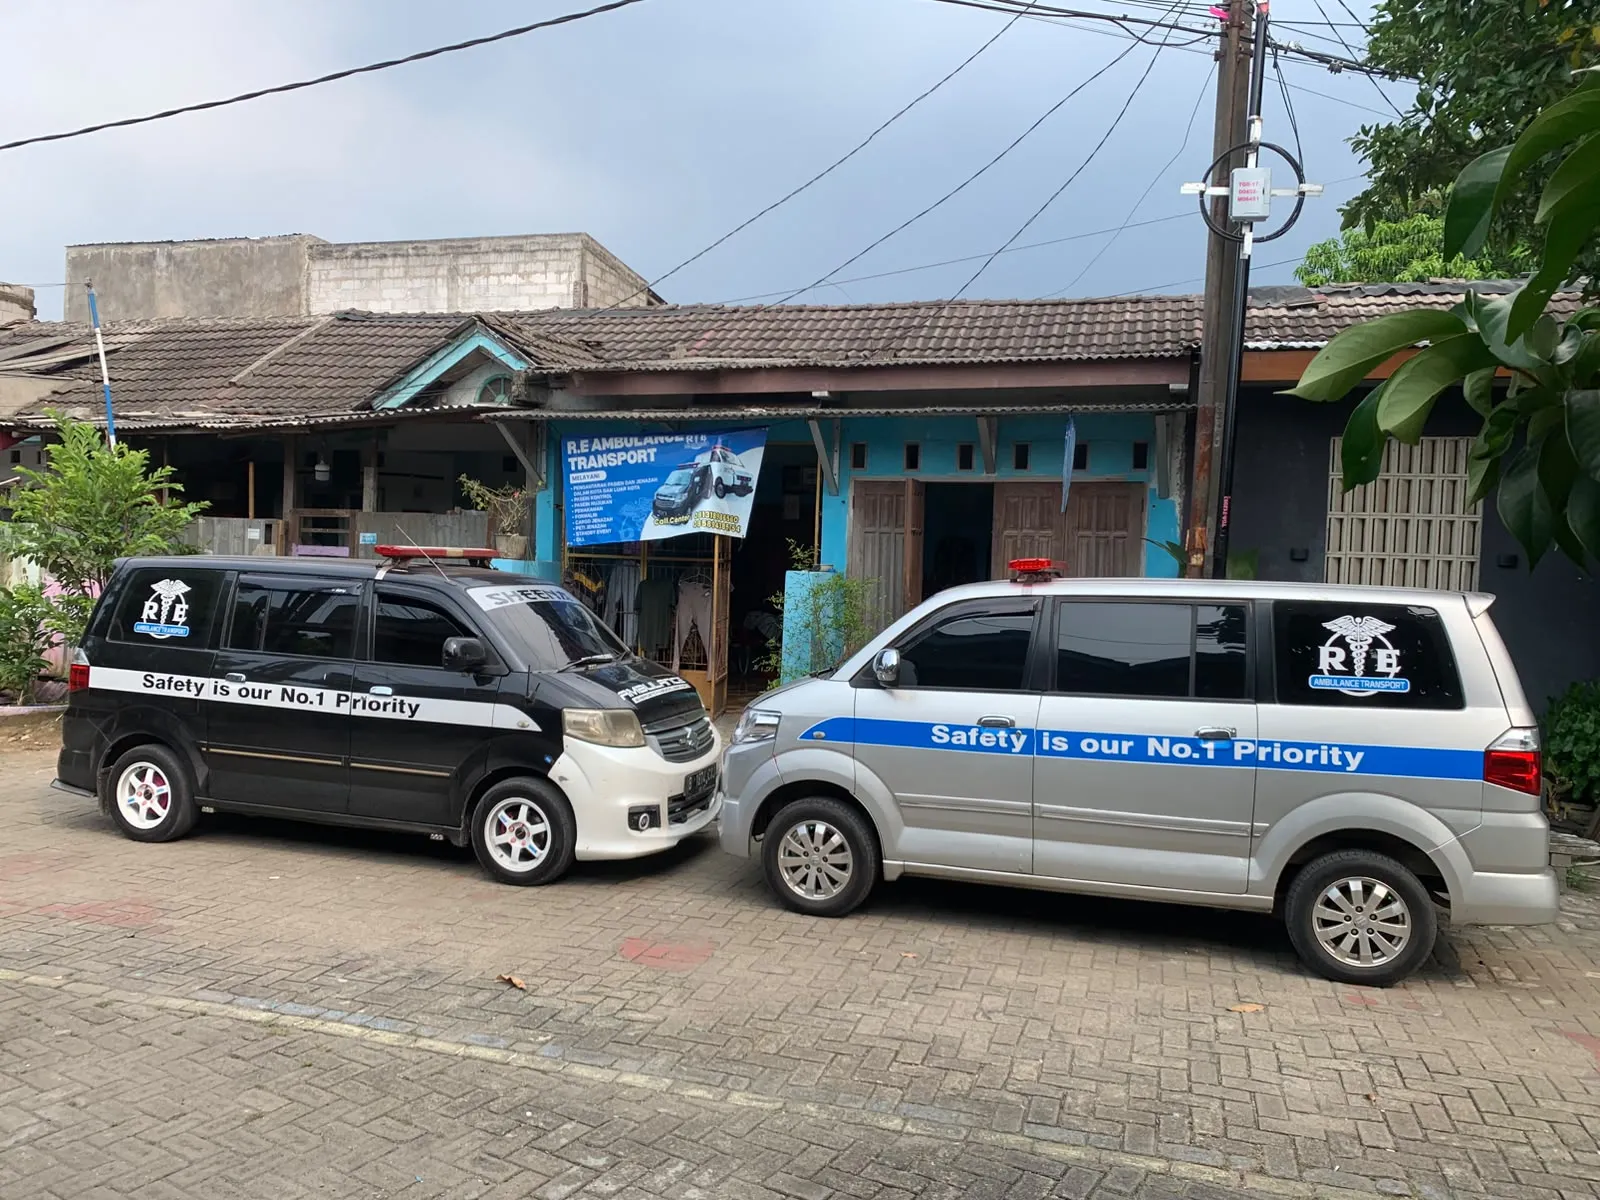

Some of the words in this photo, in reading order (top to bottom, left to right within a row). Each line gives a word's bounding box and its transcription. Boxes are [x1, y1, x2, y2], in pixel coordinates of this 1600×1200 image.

[568, 448, 657, 471] TRANSPORT
[571, 473, 600, 482] MELAYANI
[140, 600, 159, 620] R
[172, 603, 189, 623] E
[1318, 646, 1349, 671] R
[1375, 648, 1402, 673] E
[1313, 678, 1360, 688] AMBULANCE
[1361, 679, 1406, 690] TRANSPORT
[142, 673, 205, 697] Safety
[213, 681, 230, 696] is
[237, 686, 272, 701] our
[280, 687, 324, 706] No.1
[336, 692, 420, 719] Priority
[931, 724, 1028, 753] Safety
[1042, 732, 1069, 751] is
[1080, 738, 1134, 755] our
[1147, 737, 1215, 760] No.1
[1234, 741, 1365, 771] Priority
